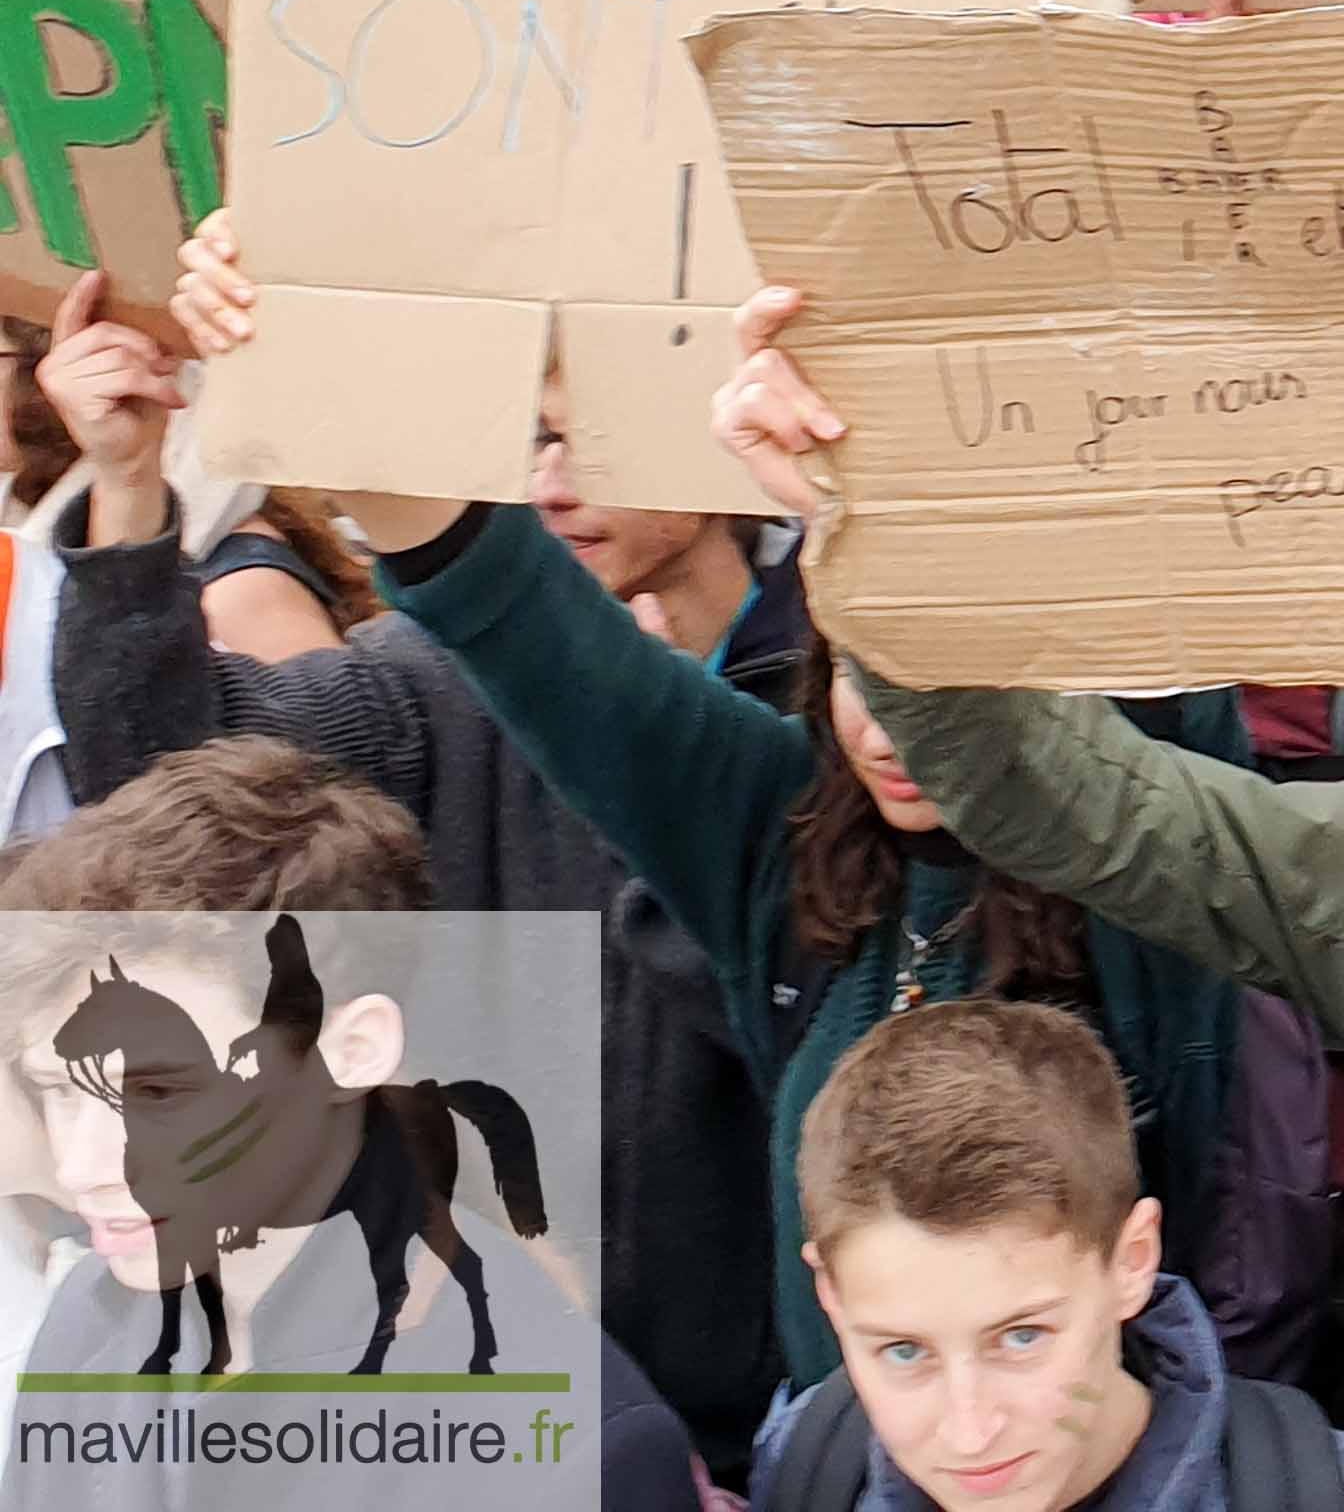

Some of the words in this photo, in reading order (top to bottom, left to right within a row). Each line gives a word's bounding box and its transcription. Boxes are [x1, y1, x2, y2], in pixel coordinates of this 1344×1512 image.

[934, 345, 1037, 448] Un
[1073, 389, 1169, 474] jour
[1193, 371, 1309, 415] nous
